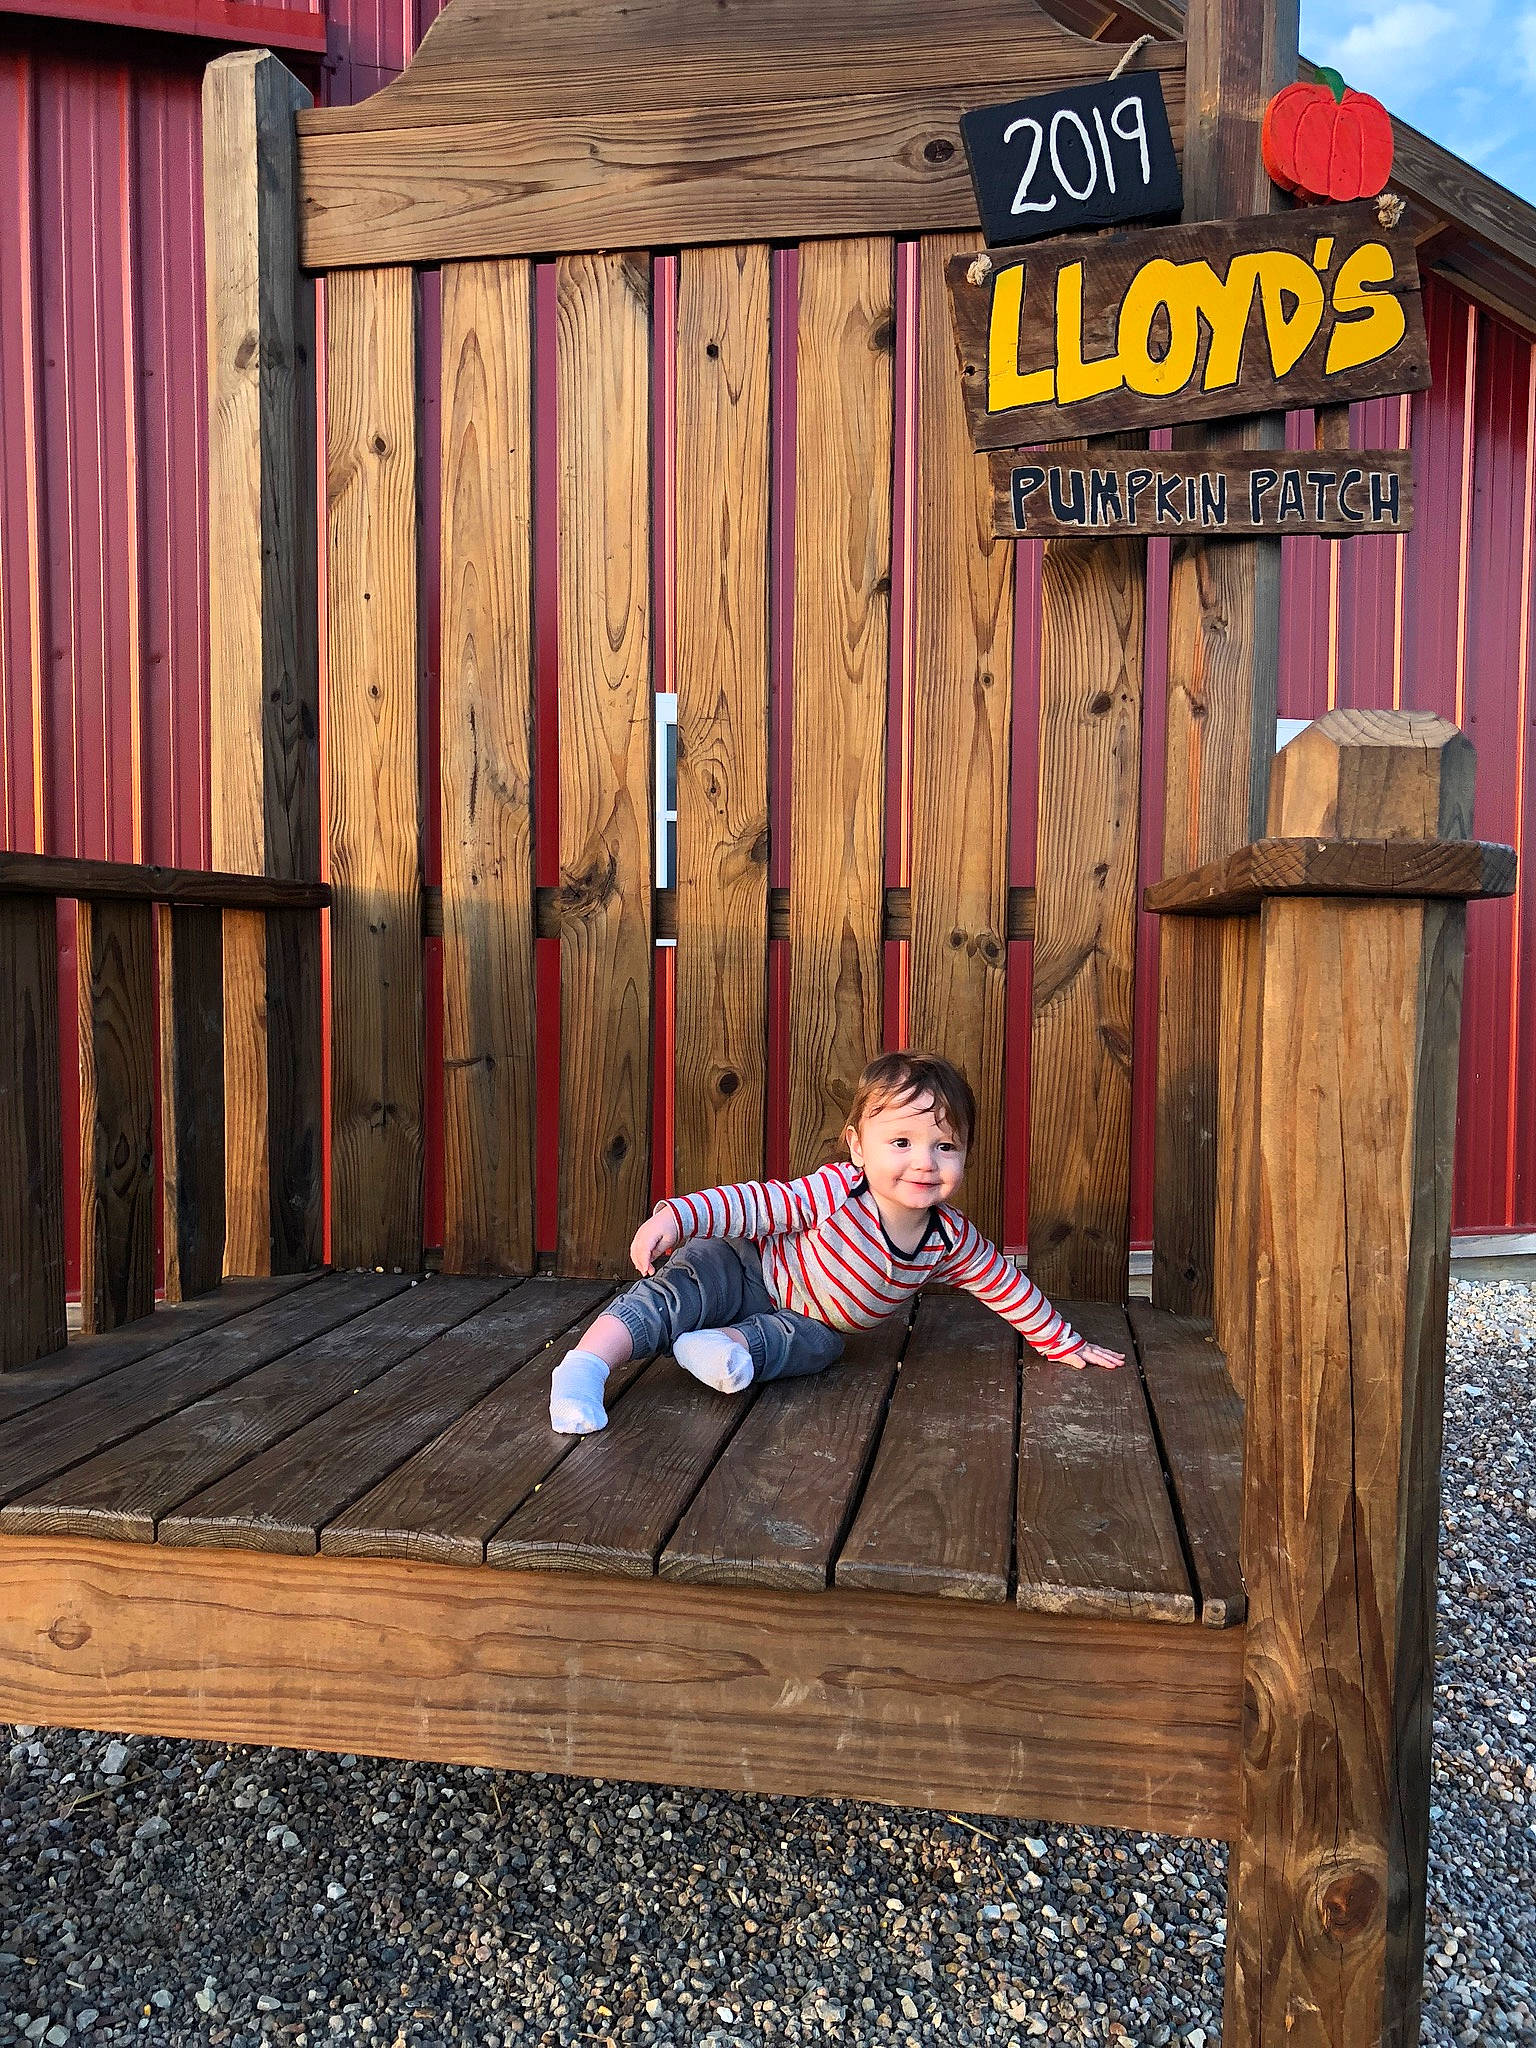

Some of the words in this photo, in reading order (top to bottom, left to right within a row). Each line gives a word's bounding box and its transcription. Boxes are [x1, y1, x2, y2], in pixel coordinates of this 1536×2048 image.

[1003, 96, 1151, 215] 2019
[986, 237, 1407, 415] LLOYD'S
[1010, 466, 1228, 531] PUMPKIN
[1249, 468, 1400, 526] PATCH
